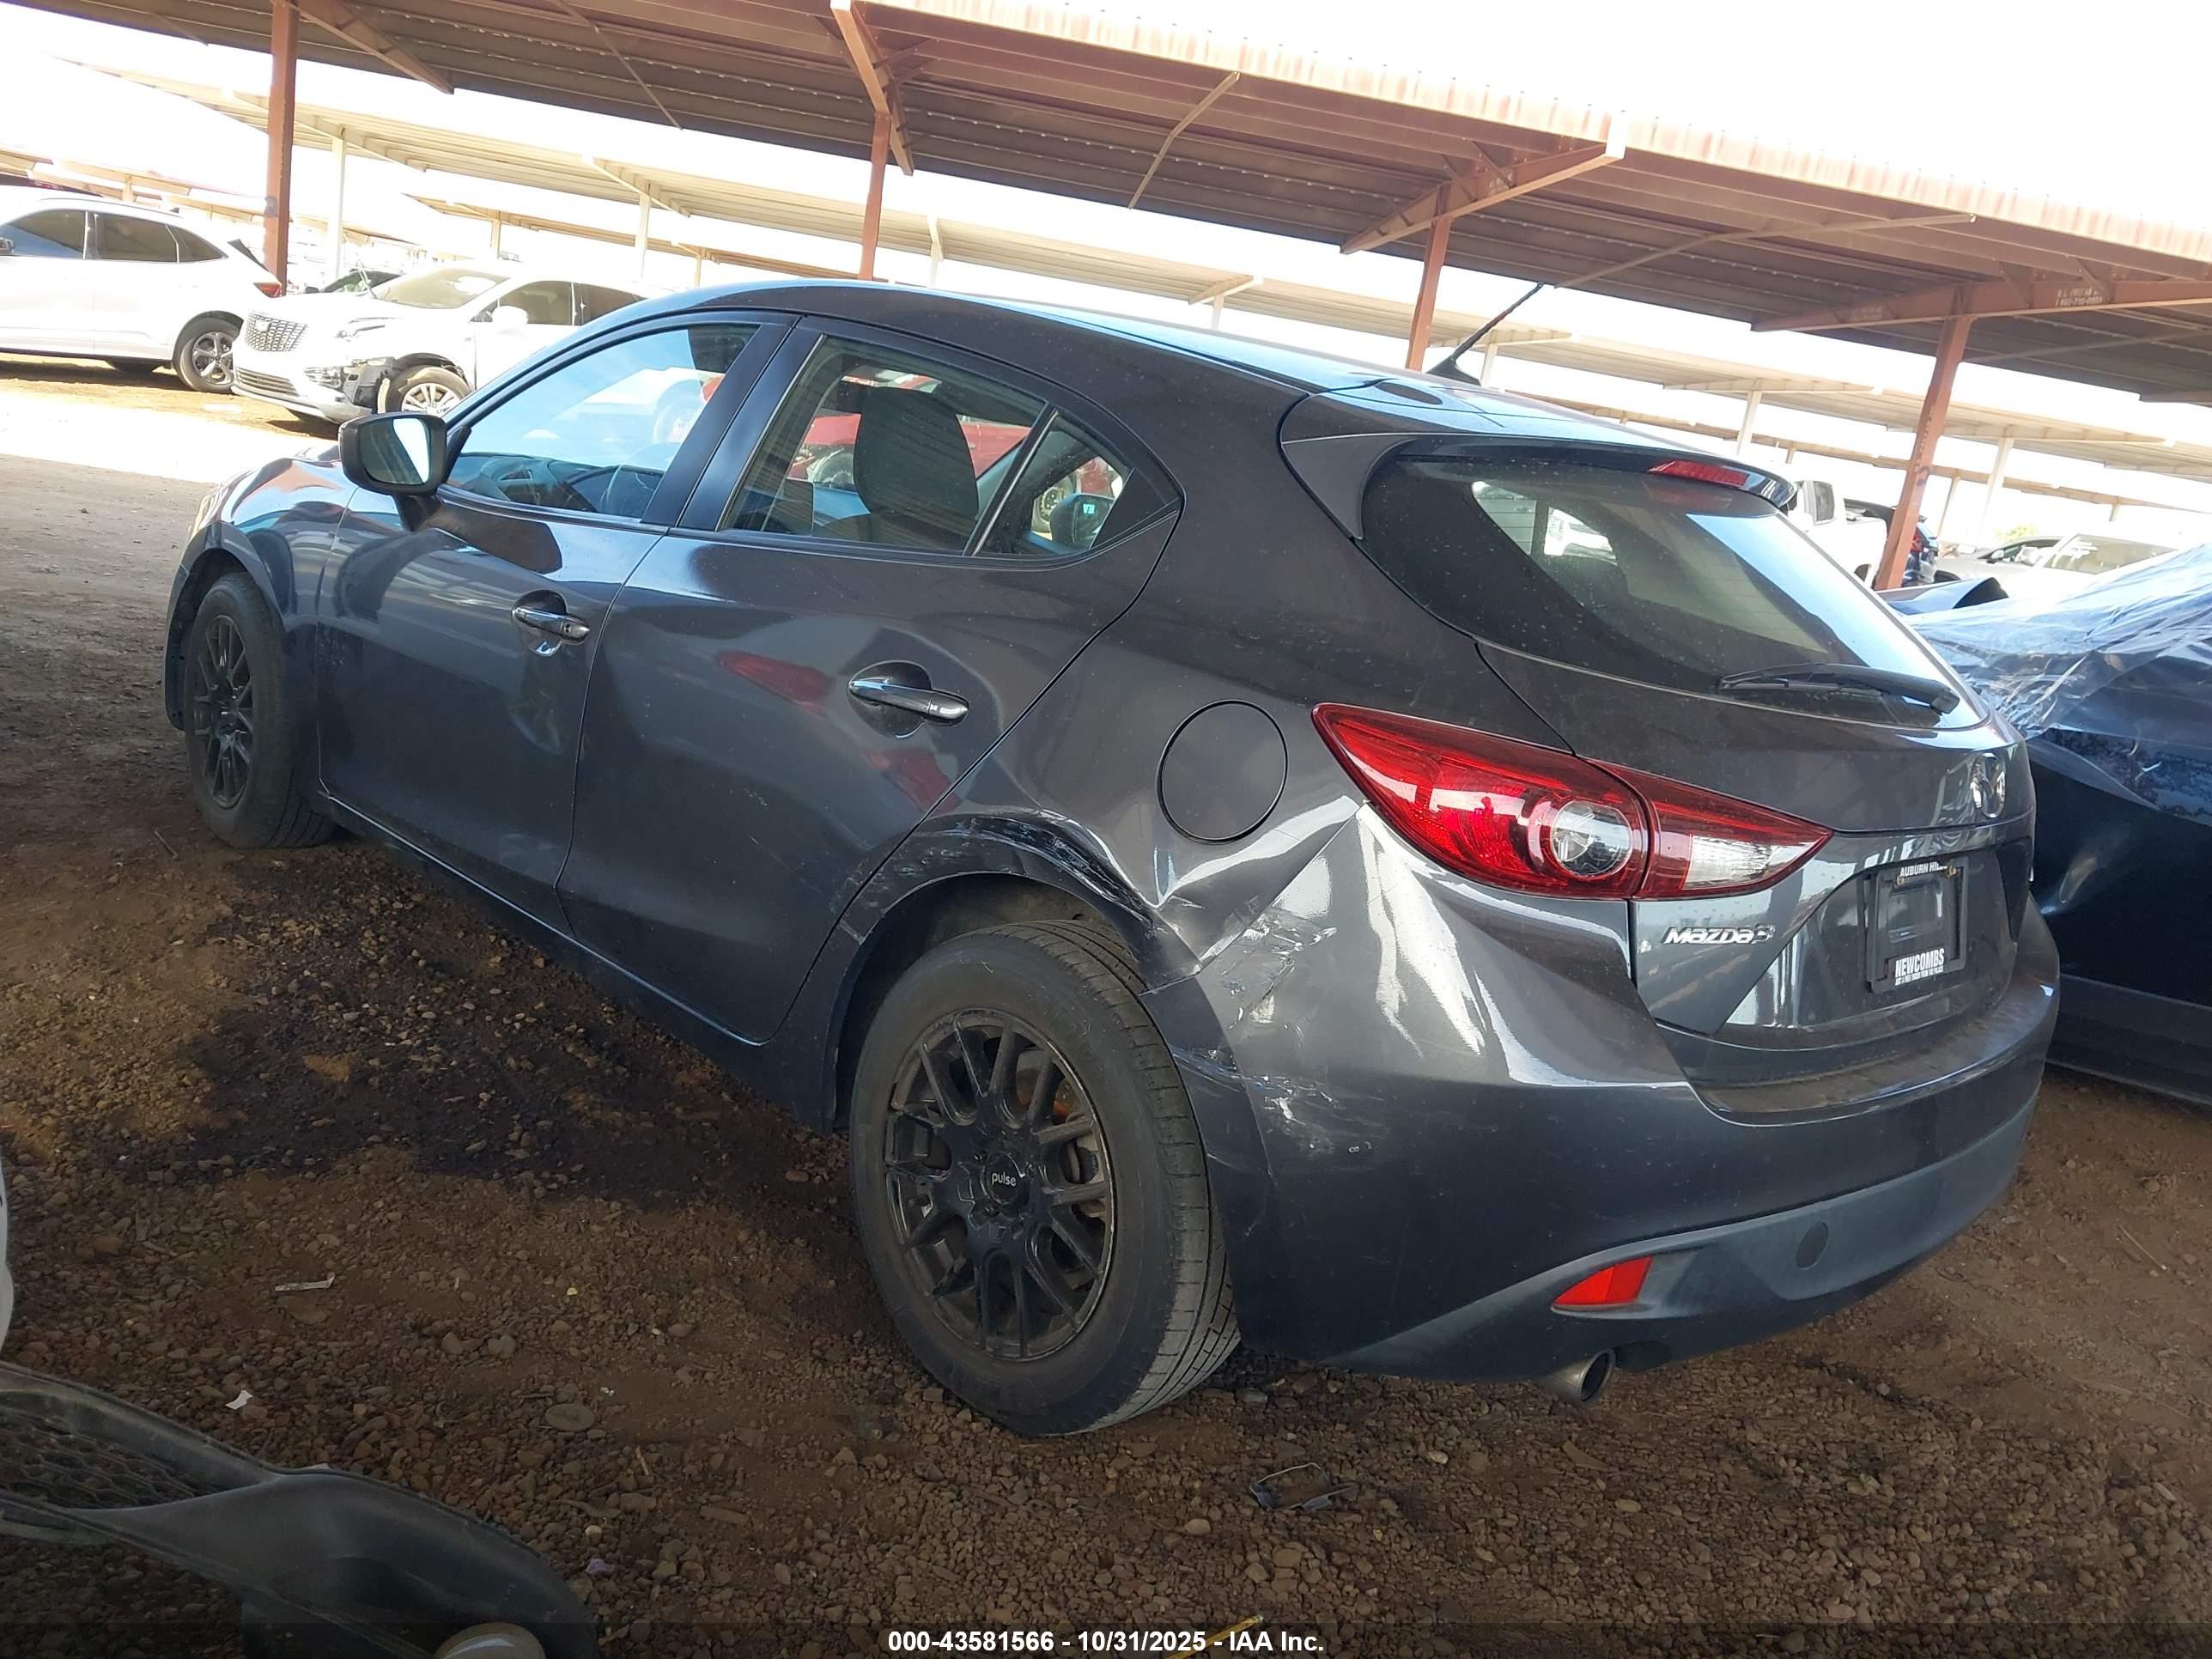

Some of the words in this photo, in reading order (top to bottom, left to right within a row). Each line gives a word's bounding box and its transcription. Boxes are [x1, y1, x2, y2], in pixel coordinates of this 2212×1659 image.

[1900, 863, 1929, 878] AUBURN
[1895, 947, 1945, 978] NEWCOMBS
[991, 1171, 1017, 1187] pulse
